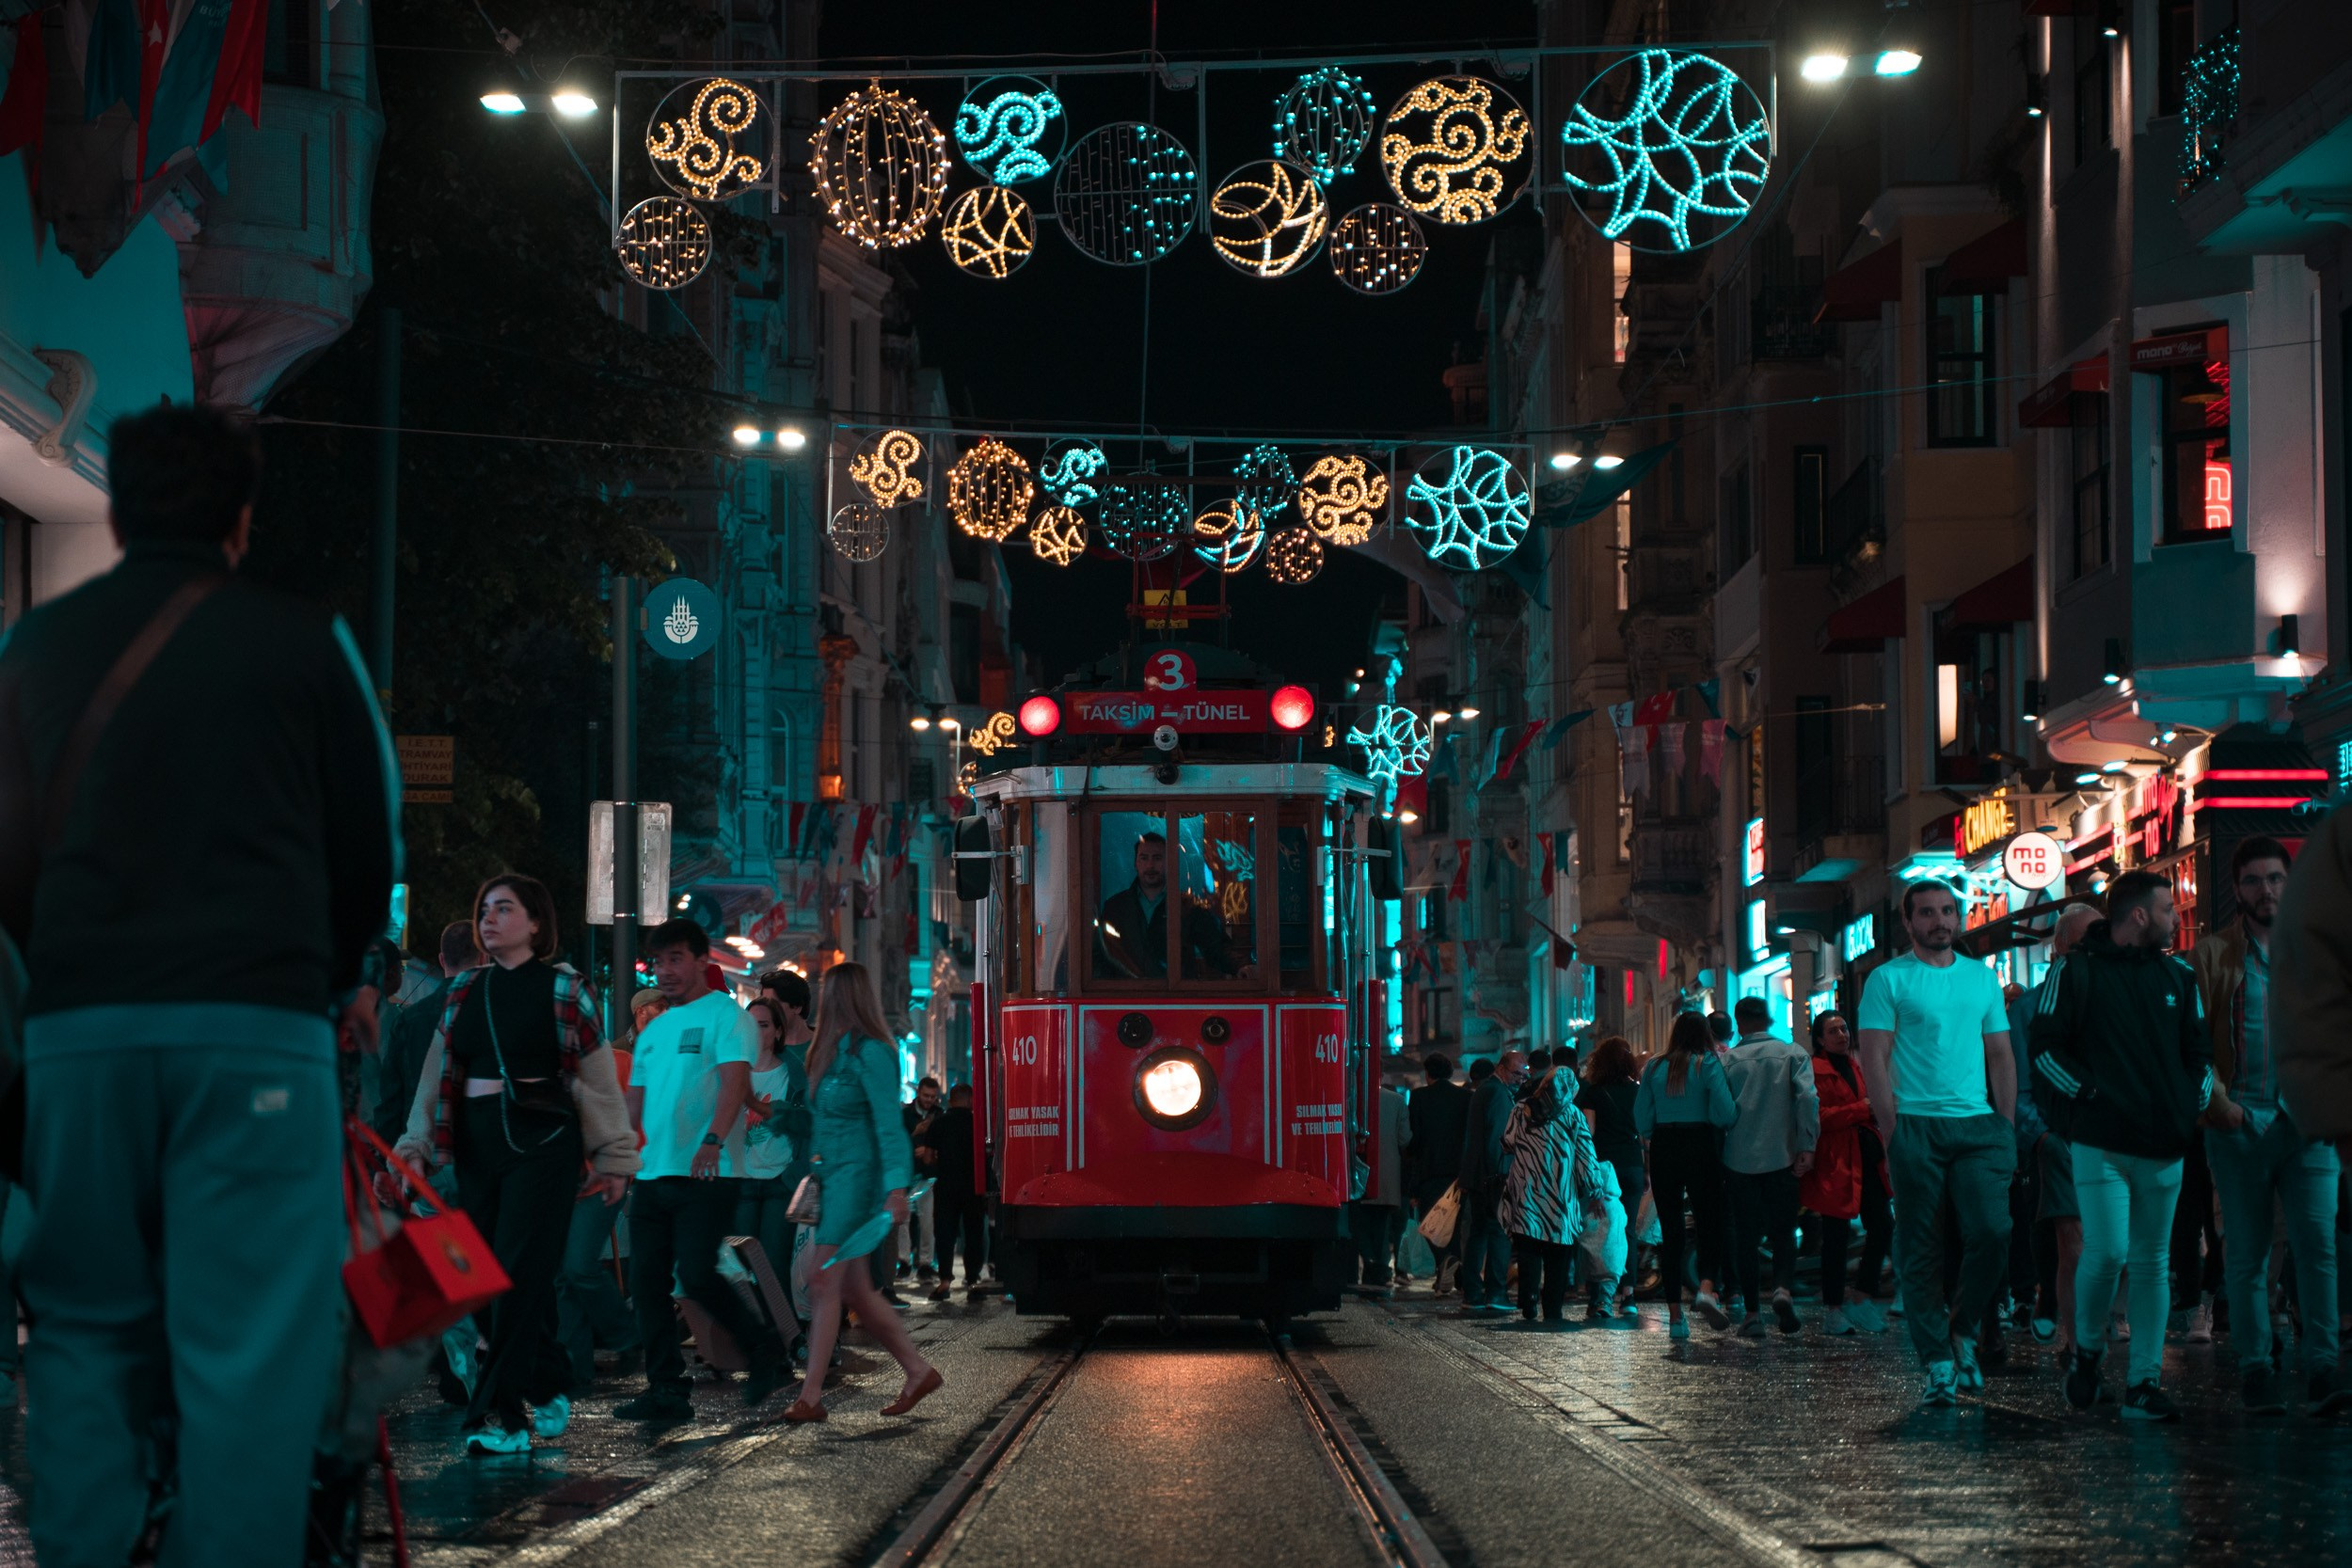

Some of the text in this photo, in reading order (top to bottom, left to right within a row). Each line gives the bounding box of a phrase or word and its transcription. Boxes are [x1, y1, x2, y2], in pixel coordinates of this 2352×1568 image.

[2137, 345, 2172, 359] mono
[1157, 654, 1184, 690] 3
[1080, 701, 1154, 721] TAKSİM
[1184, 701, 1250, 721] TÜNEL
[399, 750, 452, 759] TRAMVAY
[1012, 1035, 1037, 1066] 410
[1315, 1033, 1338, 1063] 410
[1031, 1105, 1059, 1119] YASAK
[1292, 1122, 1302, 1136] VE
